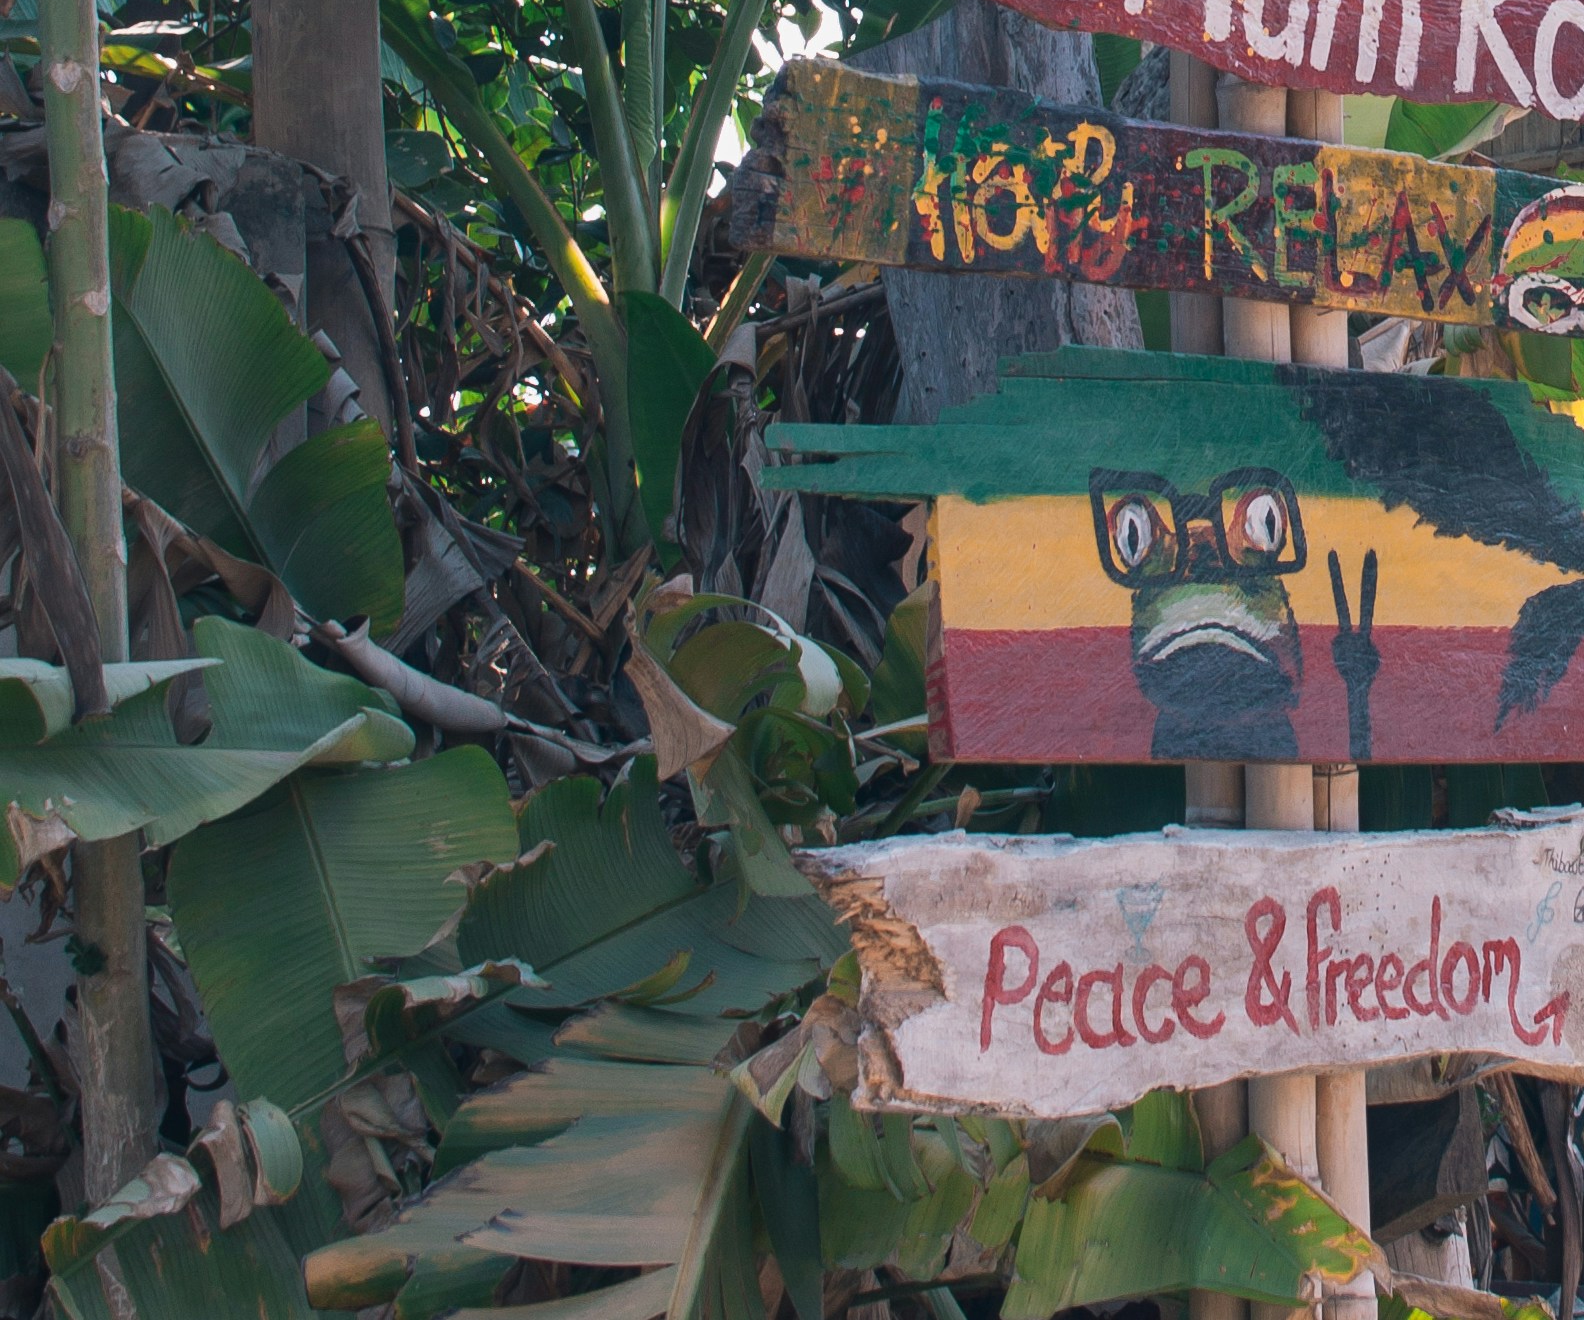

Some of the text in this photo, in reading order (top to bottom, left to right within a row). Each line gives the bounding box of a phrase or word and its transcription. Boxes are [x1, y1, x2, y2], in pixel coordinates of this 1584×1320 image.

[1184, 147, 1493, 315] RELAX
[978, 924, 1227, 1056] Peace
[1243, 895, 1300, 1036] &
